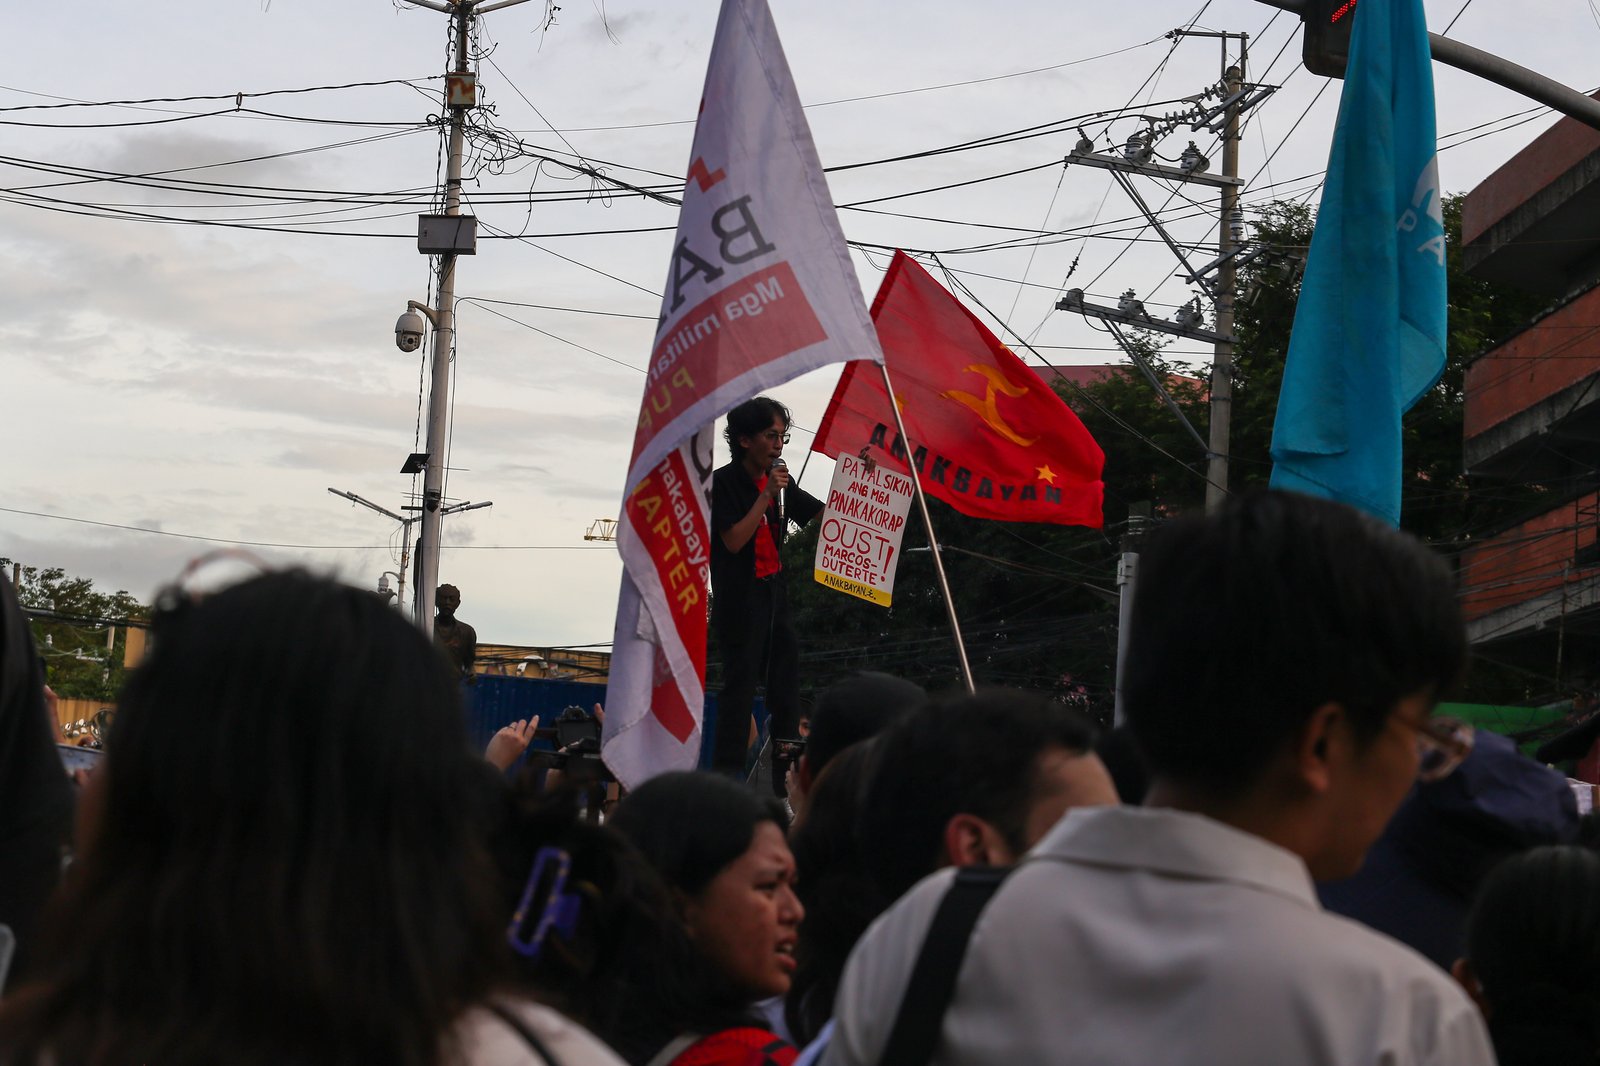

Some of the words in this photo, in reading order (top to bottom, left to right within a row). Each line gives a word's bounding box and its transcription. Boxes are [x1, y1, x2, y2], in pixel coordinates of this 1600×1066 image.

[868, 422, 1063, 505] ANAKBAYAN
[828, 490, 903, 532] PINAKAKORAP
[847, 481, 869, 497] ANG
[870, 488, 890, 506] MGA
[822, 557, 878, 586] DUTERTE
